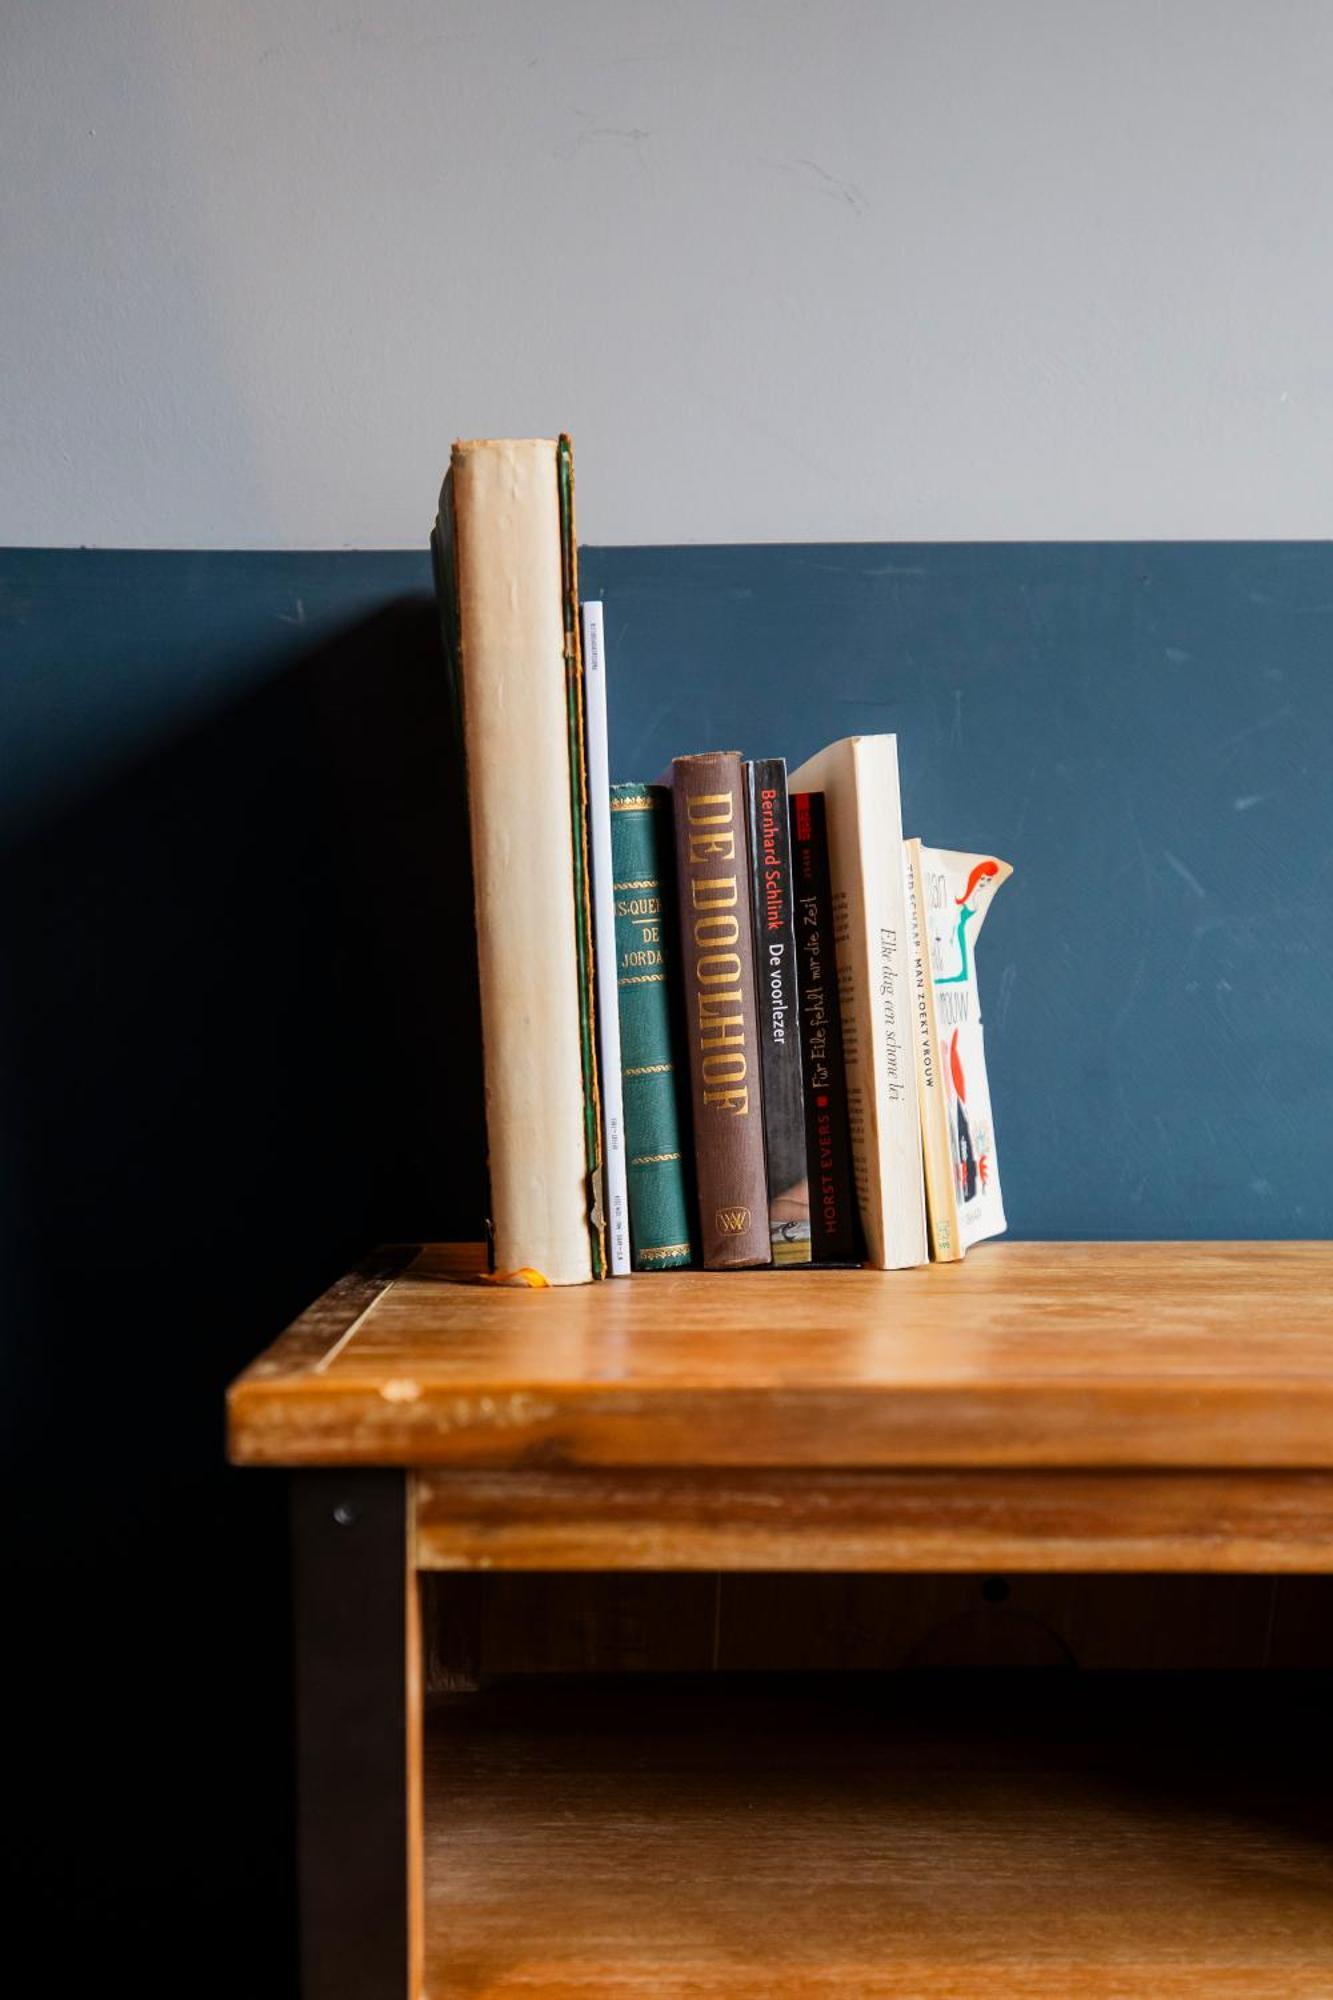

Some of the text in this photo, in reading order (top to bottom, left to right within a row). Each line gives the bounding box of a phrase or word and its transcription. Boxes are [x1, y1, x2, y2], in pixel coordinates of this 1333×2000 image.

[762, 790, 784, 930] Bernhard Schlink
[800, 896, 817, 926] Zeit
[643, 928, 659, 943] DE
[687, 791, 749, 1115] DE DOOLHOF
[804, 932, 820, 956] die
[809, 957, 820, 979] mir
[914, 958, 924, 988] MAN
[769, 944, 788, 1044] De voorlezer
[880, 928, 904, 1101] Elke dag een schone lei
[918, 993, 928, 1035] ZOEKT
[809, 1028, 827, 1060] Eile
[811, 1064, 829, 1088] Für
[922, 1040, 934, 1088] VROUW
[818, 1114, 836, 1233] HORST EVERS
